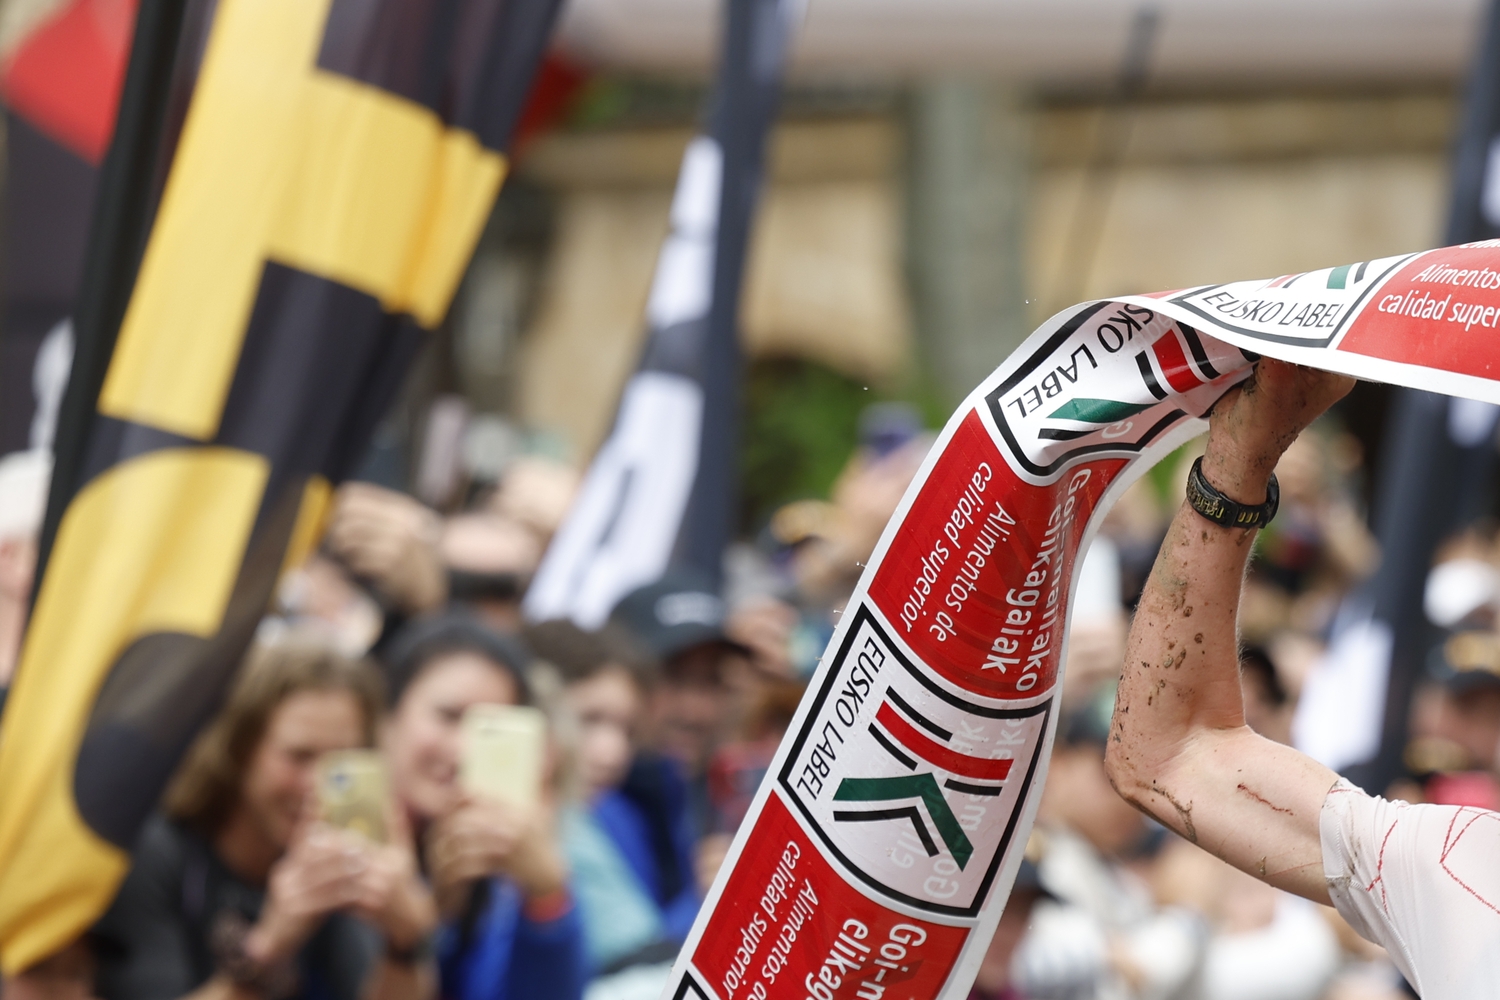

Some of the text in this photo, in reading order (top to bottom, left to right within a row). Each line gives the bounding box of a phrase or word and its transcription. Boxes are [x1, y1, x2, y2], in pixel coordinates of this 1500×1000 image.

[1007, 343, 1098, 418] LABEL
[1202, 291, 1344, 328] EUSKO LABEL
[1378, 290, 1452, 321] calidad
[899, 462, 993, 633] calidad superior
[929, 501, 1017, 642] Alimentos de
[981, 504, 1062, 674] elikagaiak
[1016, 468, 1092, 692] Goi-mailako
[797, 636, 886, 801] EUSKO LABEL
[727, 840, 801, 1000] calidad superior
[762, 877, 820, 985] Alimentos
